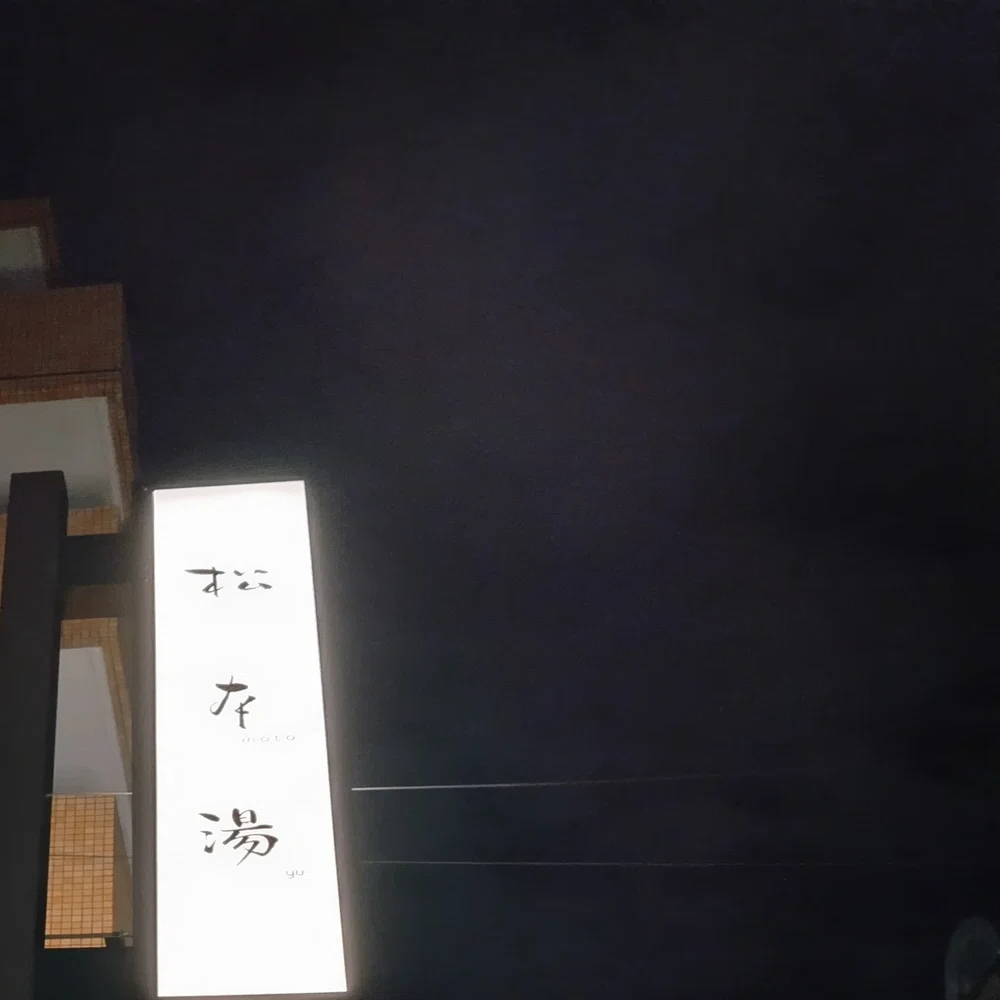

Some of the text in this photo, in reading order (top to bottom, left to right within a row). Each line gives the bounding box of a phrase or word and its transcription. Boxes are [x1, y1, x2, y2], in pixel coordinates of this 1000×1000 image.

[184, 566, 279, 867] 松本湯
[285, 869, 305, 879] yu
